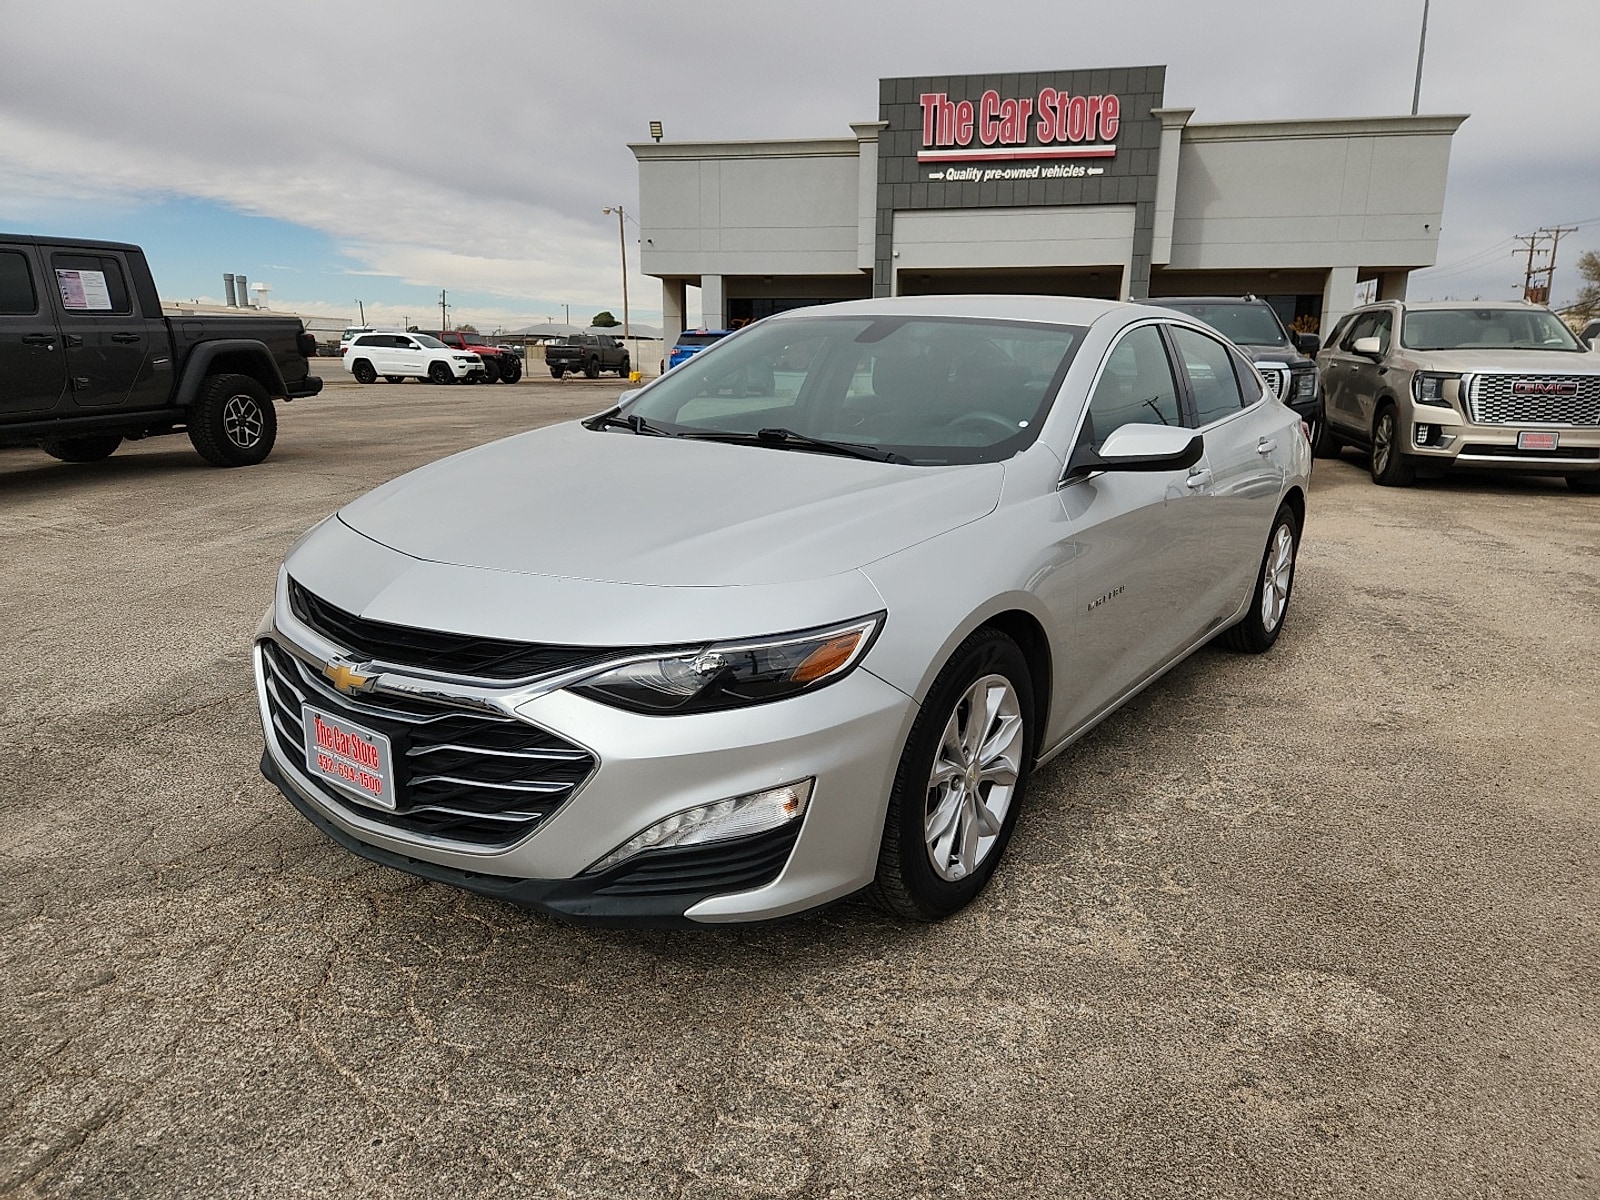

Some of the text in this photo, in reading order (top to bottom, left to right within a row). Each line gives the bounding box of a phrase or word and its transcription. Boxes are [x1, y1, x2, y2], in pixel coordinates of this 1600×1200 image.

[920, 87, 1121, 147] The Car Store
[945, 164, 1085, 182] Quality pre-owned vehicles
[1515, 383, 1576, 394] GMC
[314, 717, 333, 747] The
[333, 725, 351, 755] Car
[350, 732, 379, 769] Store
